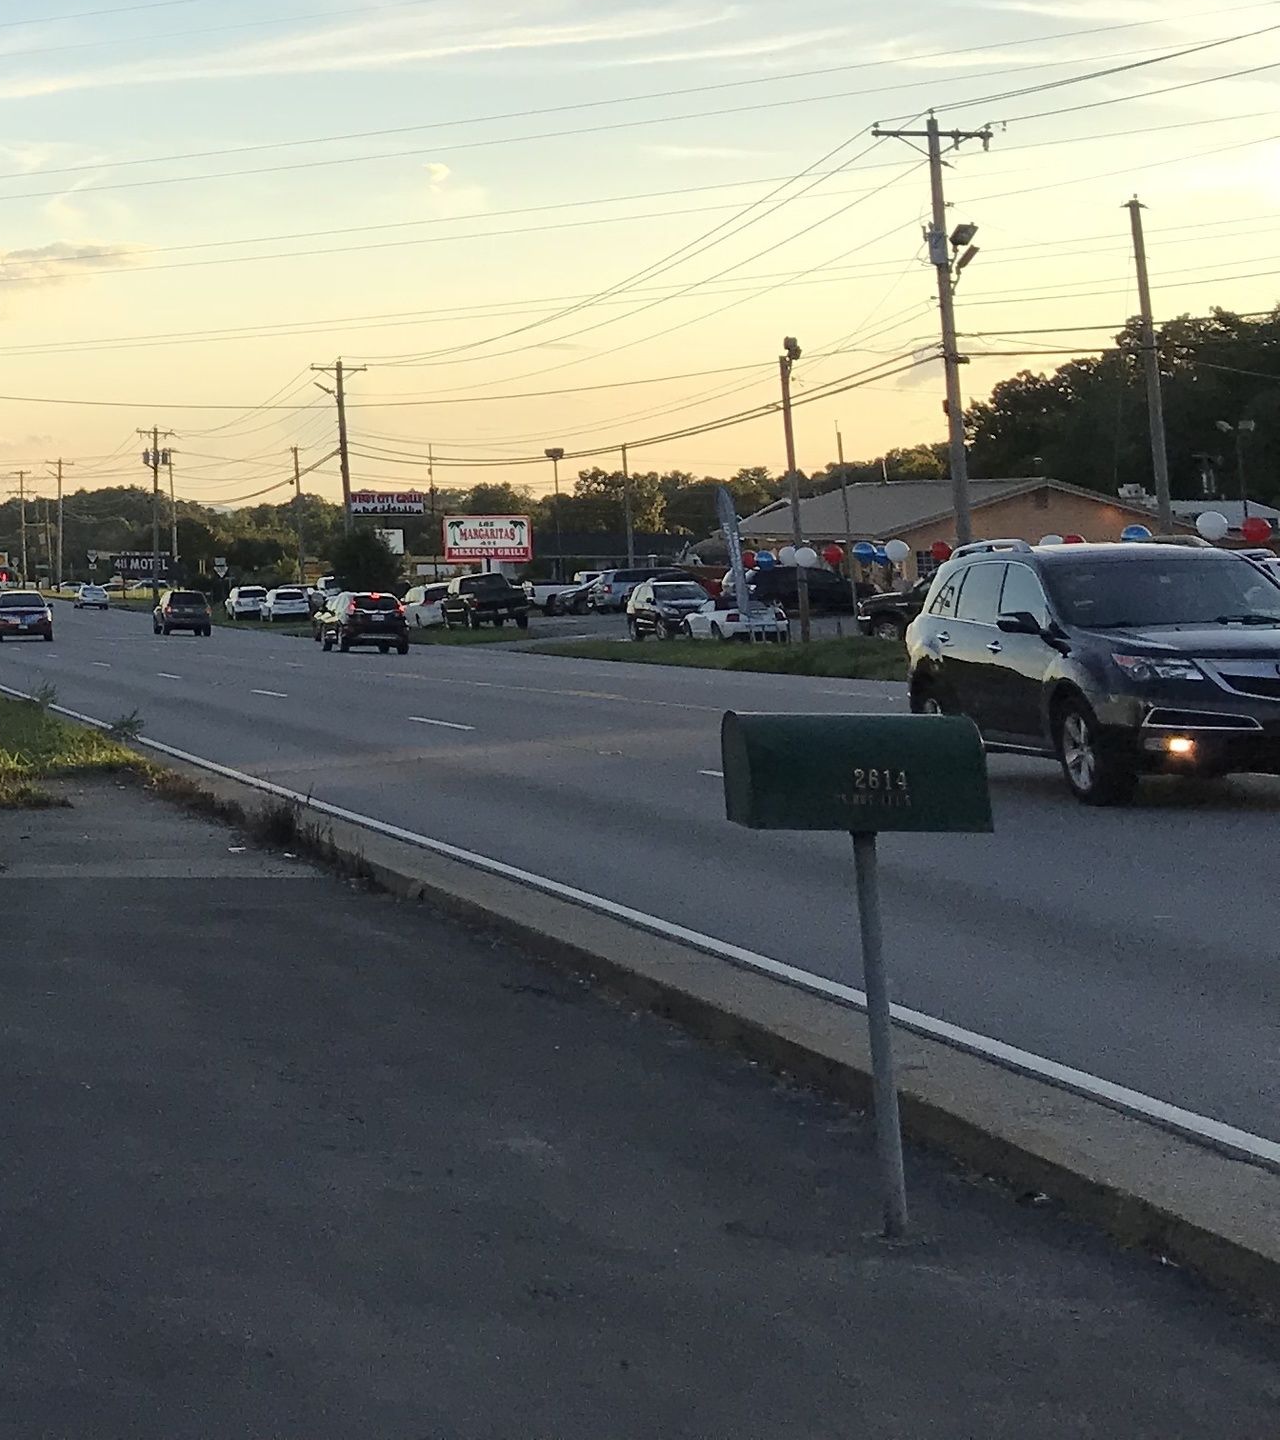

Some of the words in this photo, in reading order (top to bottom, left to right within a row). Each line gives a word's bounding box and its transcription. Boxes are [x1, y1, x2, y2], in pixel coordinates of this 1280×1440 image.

[459, 528, 515, 540] MARGARITAS
[451, 548, 495, 556] MEXICAN
[497, 548, 526, 556] GRILL
[853, 768, 907, 791] 2614
